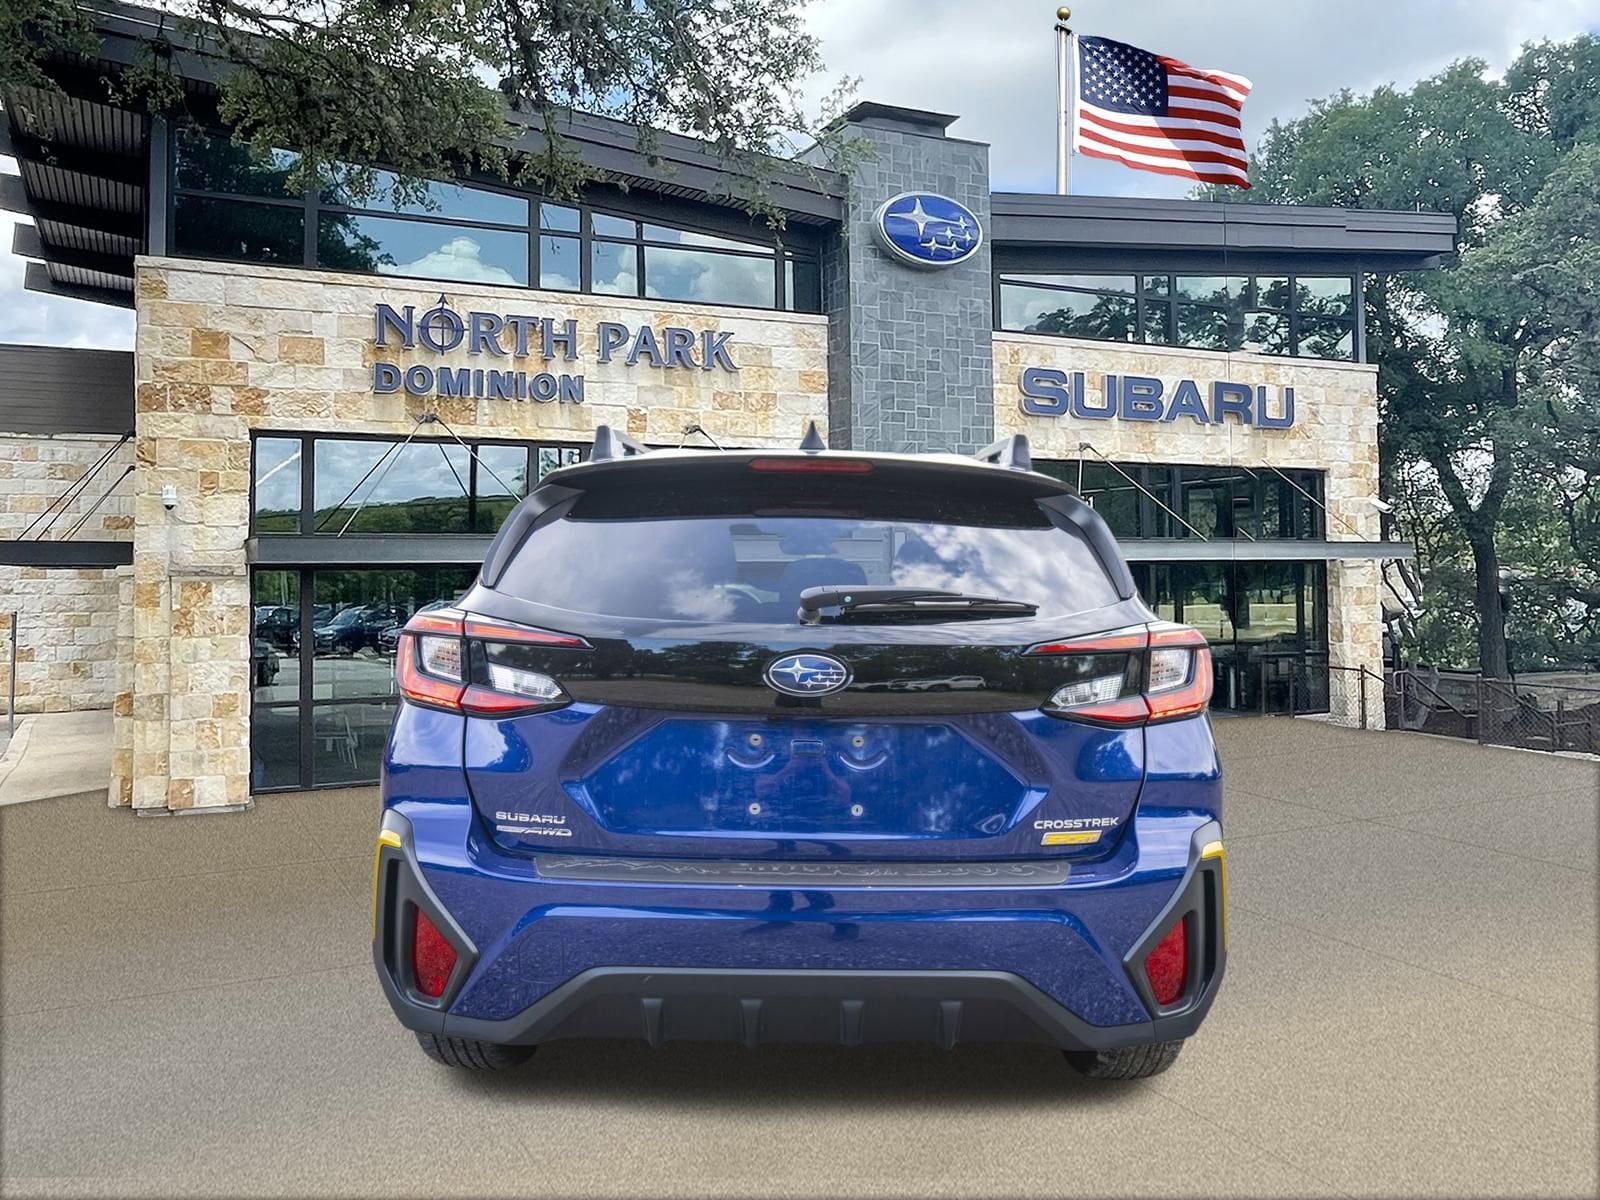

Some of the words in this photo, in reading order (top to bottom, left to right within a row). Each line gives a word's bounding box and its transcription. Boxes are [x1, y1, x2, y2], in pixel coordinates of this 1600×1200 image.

[375, 293, 579, 362] NORTH
[597, 321, 740, 373] PARK
[374, 363, 585, 404] DOMINION
[1020, 367, 1295, 430] SUBARU
[495, 811, 566, 824] SUBARU
[1033, 817, 1119, 829] CROSSTREK
